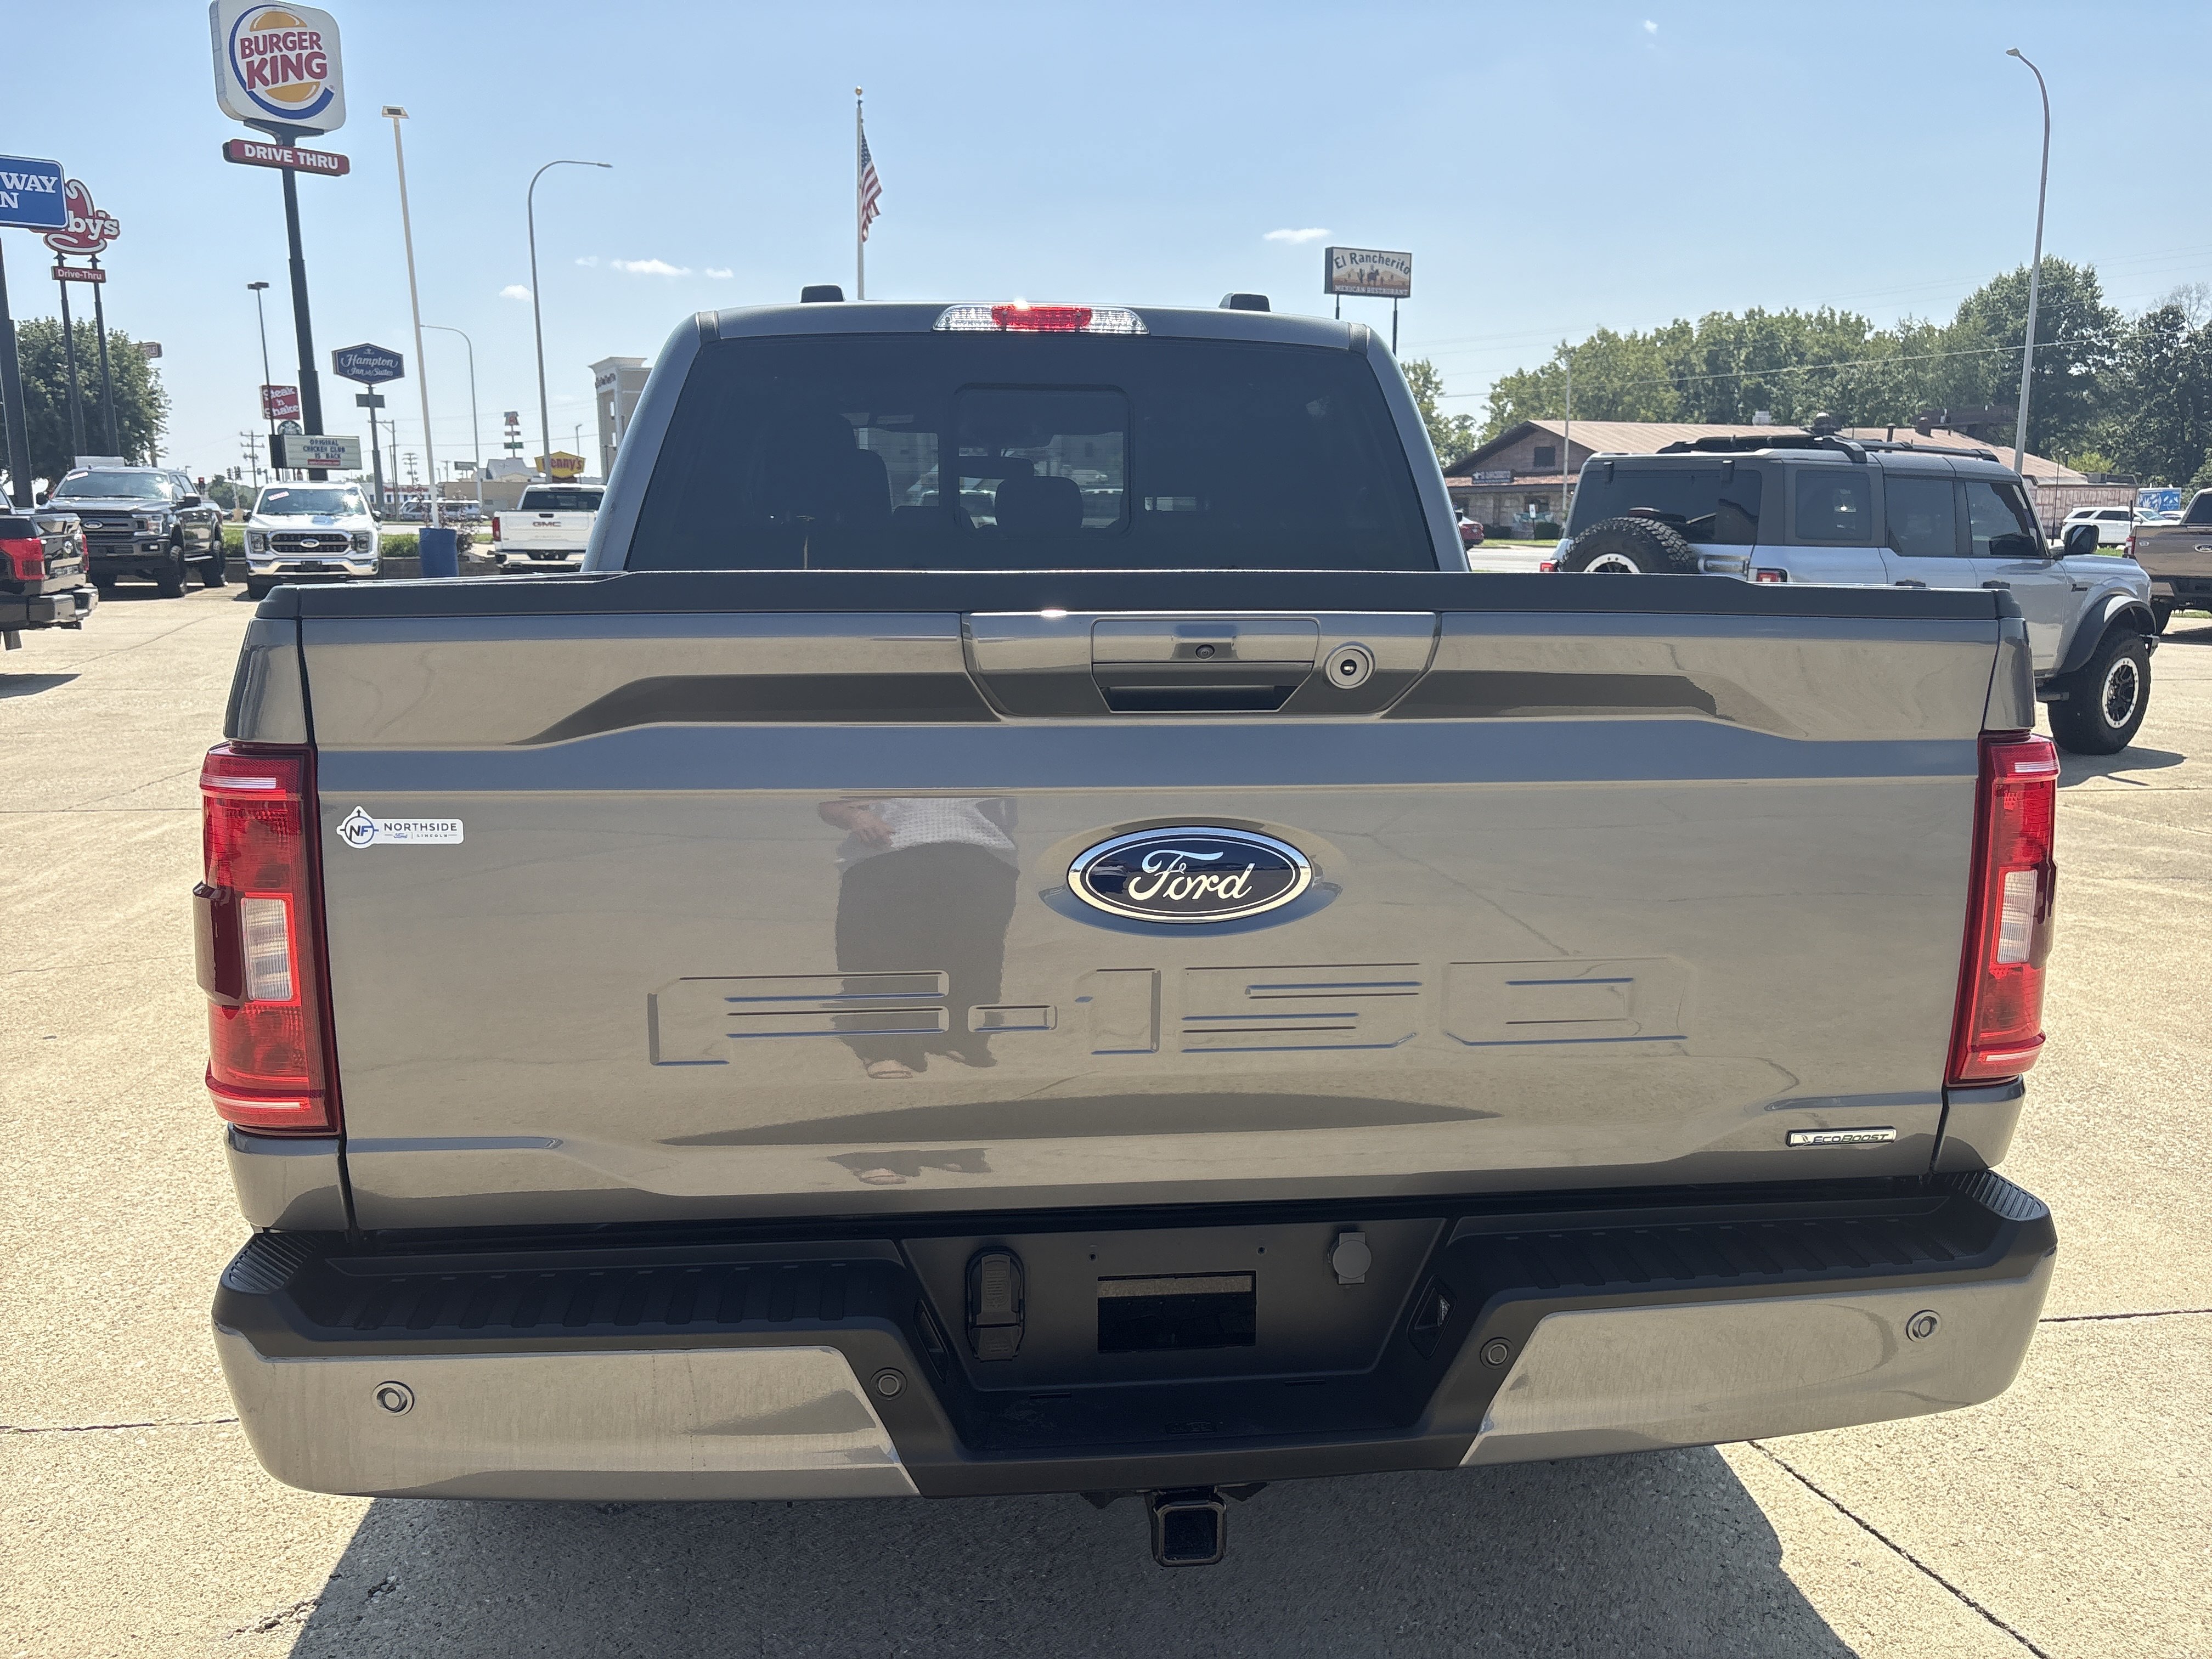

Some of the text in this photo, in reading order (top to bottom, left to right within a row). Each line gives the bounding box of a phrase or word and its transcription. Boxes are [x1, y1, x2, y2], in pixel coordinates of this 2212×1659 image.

[240, 31, 323, 60] BURGER
[245, 51, 328, 90] KING
[244, 144, 339, 170] DRIVE THRU
[68, 210, 120, 240] by's
[58, 269, 102, 280] Drive-Thru
[1334, 252, 1410, 275] El Rancherito
[340, 353, 399, 368] Hampton
[541, 457, 582, 471] enny's
[384, 823, 458, 831] NORTHSIDE
[1128, 849, 1256, 901] Ford
